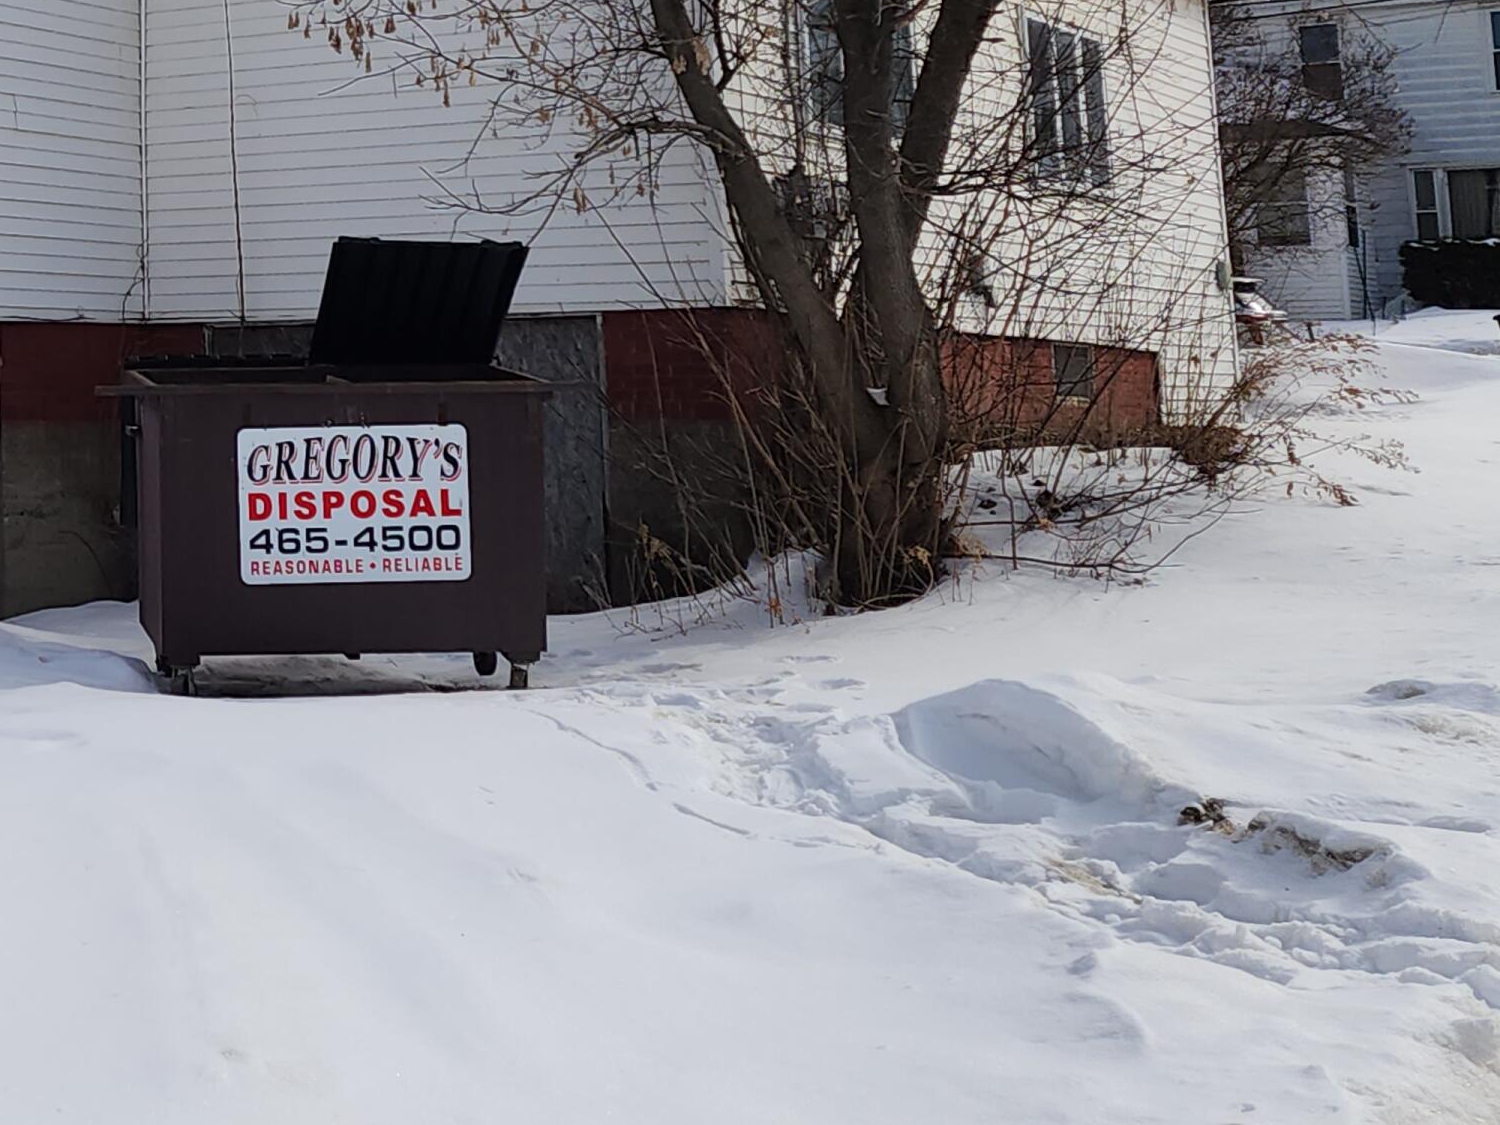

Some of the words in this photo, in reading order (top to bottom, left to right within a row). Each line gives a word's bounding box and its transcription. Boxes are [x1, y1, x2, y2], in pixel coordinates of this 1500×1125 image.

[246, 433, 463, 485] GREGORY'S
[247, 488, 462, 521] DISPOSAL
[249, 525, 461, 554] 465-4500
[250, 558, 364, 576] REASONABLE
[382, 556, 463, 573] RELIABLE
